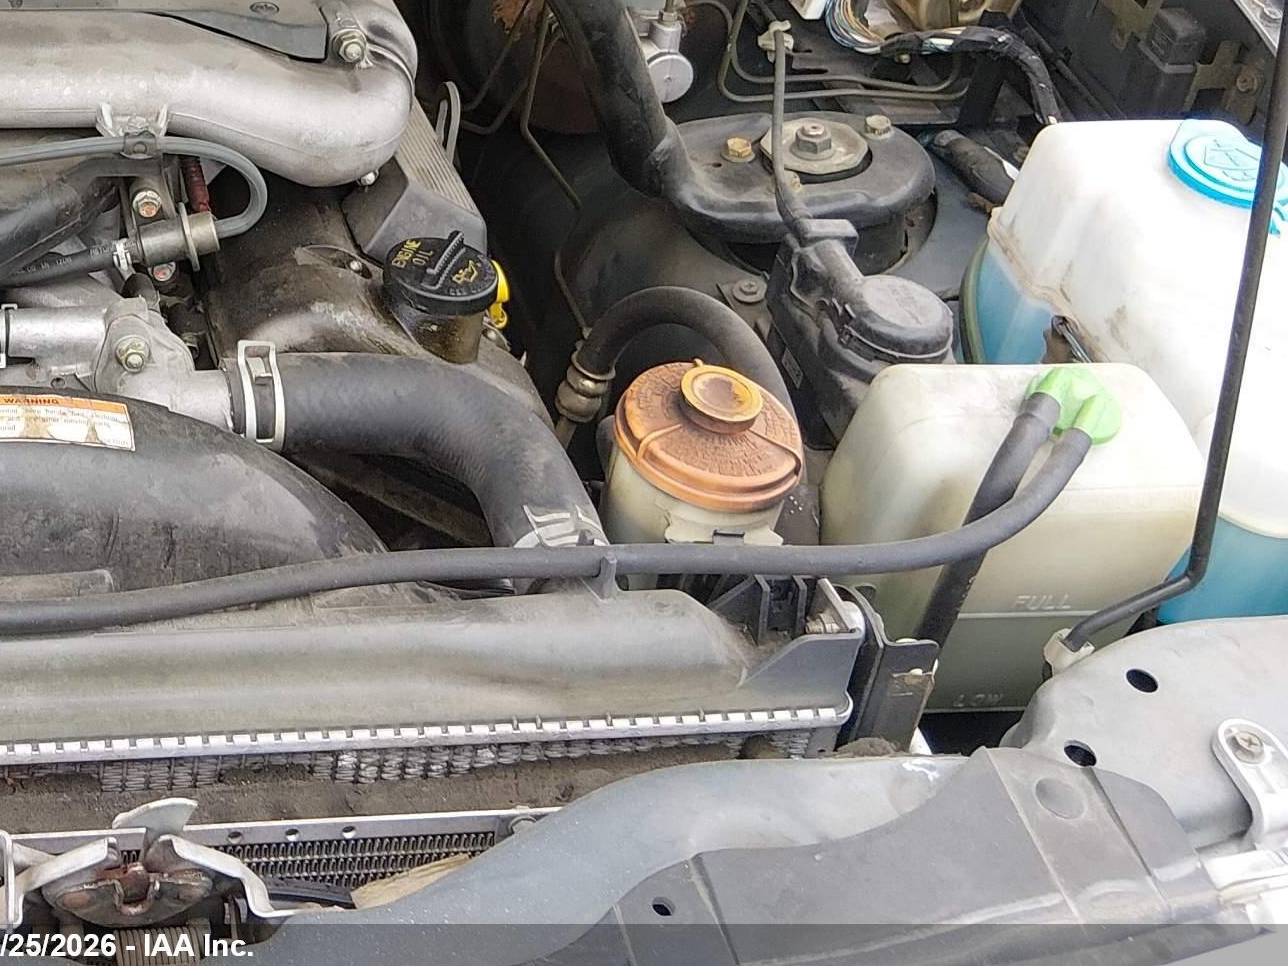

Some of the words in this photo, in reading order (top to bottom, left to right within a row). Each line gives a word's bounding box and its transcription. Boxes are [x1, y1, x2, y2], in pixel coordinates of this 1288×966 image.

[391, 239, 421, 268] ENGINE
[411, 250, 434, 266] OIL
[1015, 593, 1071, 611] FULL
[952, 693, 1004, 708] LOW
